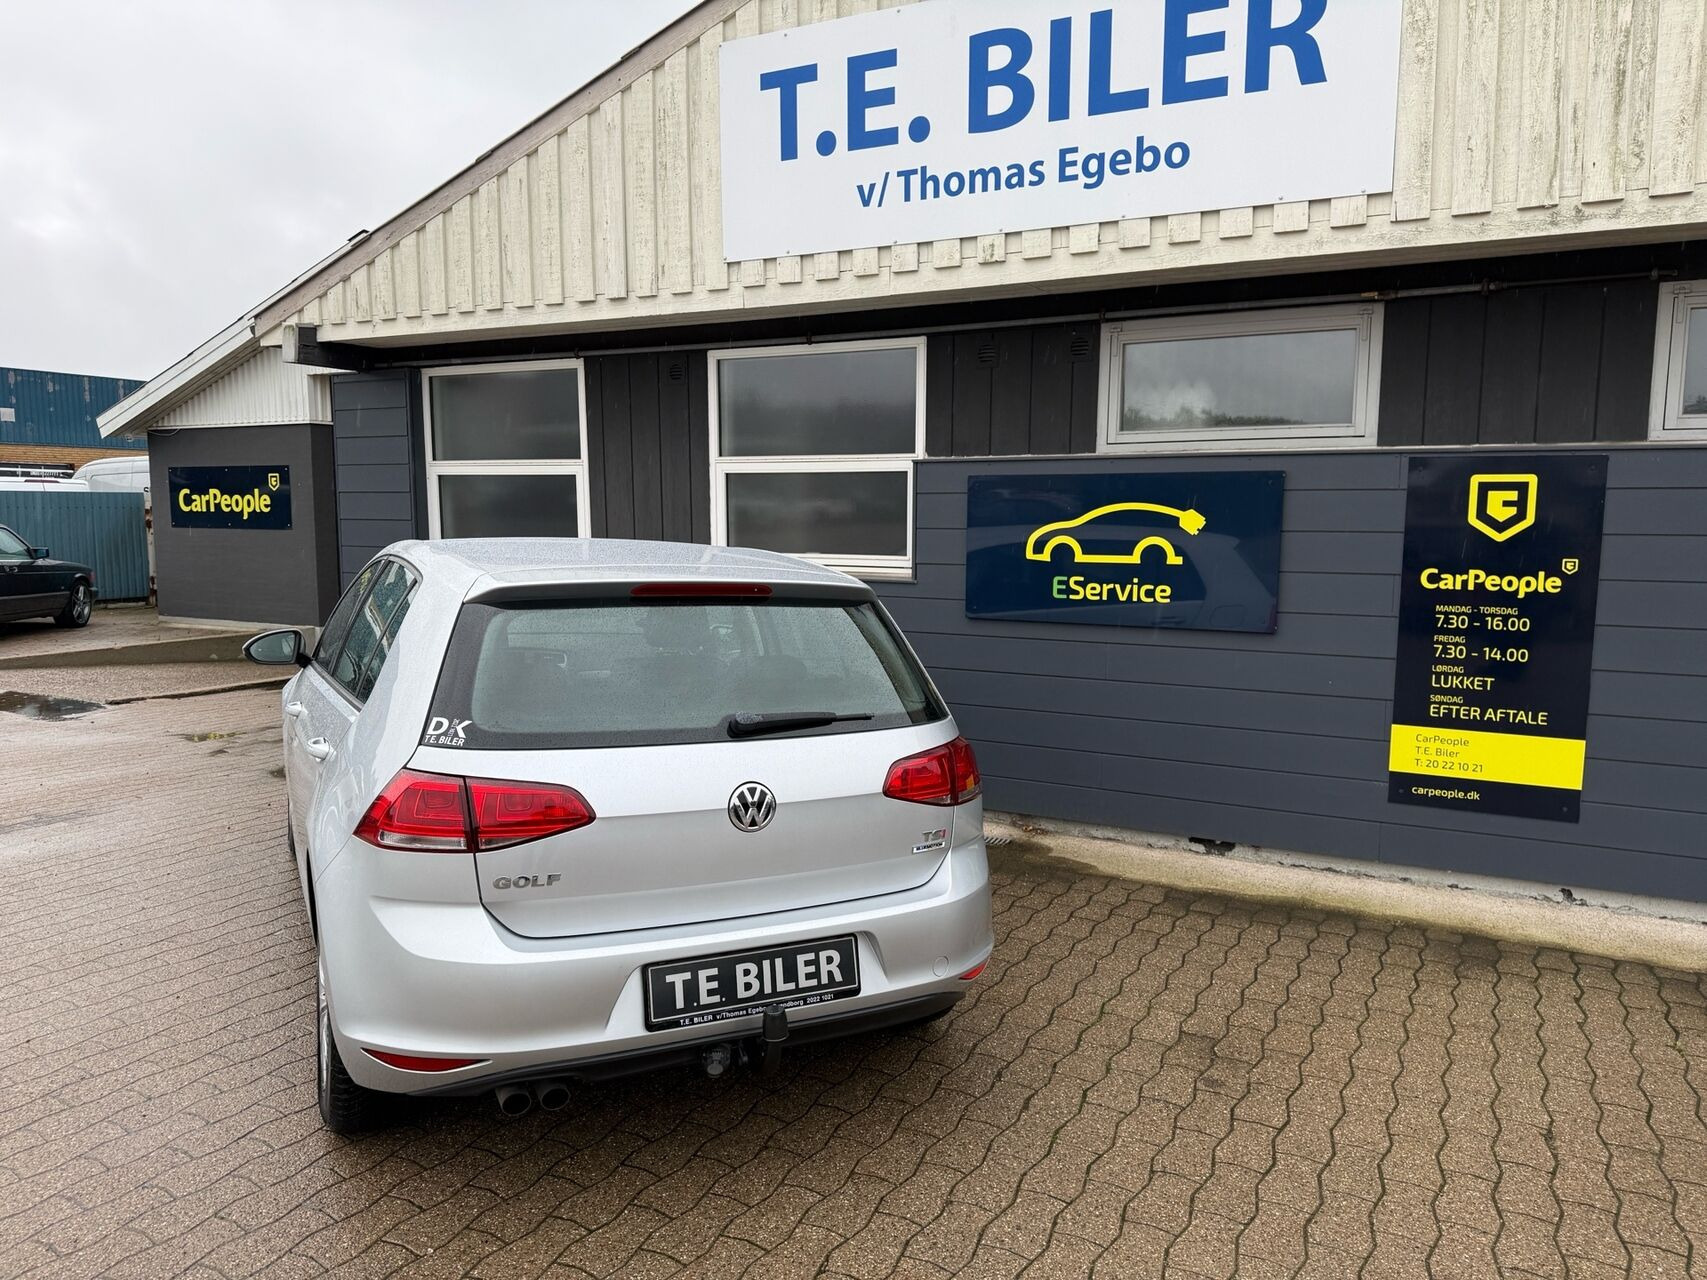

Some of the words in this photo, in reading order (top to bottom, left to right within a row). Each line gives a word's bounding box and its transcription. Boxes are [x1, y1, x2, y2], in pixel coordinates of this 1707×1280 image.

[760, 49, 931, 162] T.E.
[967, 0, 1328, 136] BILER
[856, 171, 892, 209] v/
[896, 159, 1046, 204] Thomas
[1057, 135, 1191, 191] Egebo
[178, 488, 271, 520] CarPeople
[1052, 575, 1172, 604] EService
[1419, 567, 1563, 599] CarPeople
[1435, 604, 1472, 614] MANDAG
[1479, 606, 1519, 616] TORSDAG
[1435, 614, 1469, 629] 7.30
[1485, 616, 1531, 632] 16.00
[1433, 634, 1466, 643] FREDAG
[1433, 644, 1467, 659] 7.30
[1483, 647, 1529, 663] 14.00
[1431, 664, 1465, 674] LØRDAG
[1431, 674, 1495, 691] LUKKET
[1429, 694, 1464, 704] SØNDAG
[1429, 704, 1481, 721] EFTER
[1484, 708, 1549, 726] AFTALE
[438, 735, 465, 747] BILER
[1415, 733, 1470, 747] CarPeople
[1415, 745, 1433, 756] T.E.
[1435, 747, 1460, 758] Biler
[1415, 758, 1423, 767] T:
[1425, 759, 1439, 769] 20
[1441, 760, 1455, 770] 22
[1458, 762, 1470, 772] 10
[1471, 763, 1483, 773] 21
[1411, 786, 1480, 801] carpeople.dk
[730, 784, 776, 831] VW
[922, 828, 946, 842] TSI
[492, 872, 562, 890] GOLF
[665, 967, 726, 1010] T.E.
[735, 949, 843, 999] BILER
[680, 1018, 692, 1026] T.E.
[693, 1014, 713, 1024] BILER
[716, 1010, 747, 1020] v/Thomas
[806, 995, 820, 1004] 2022
[821, 993, 834, 1001] 1021
